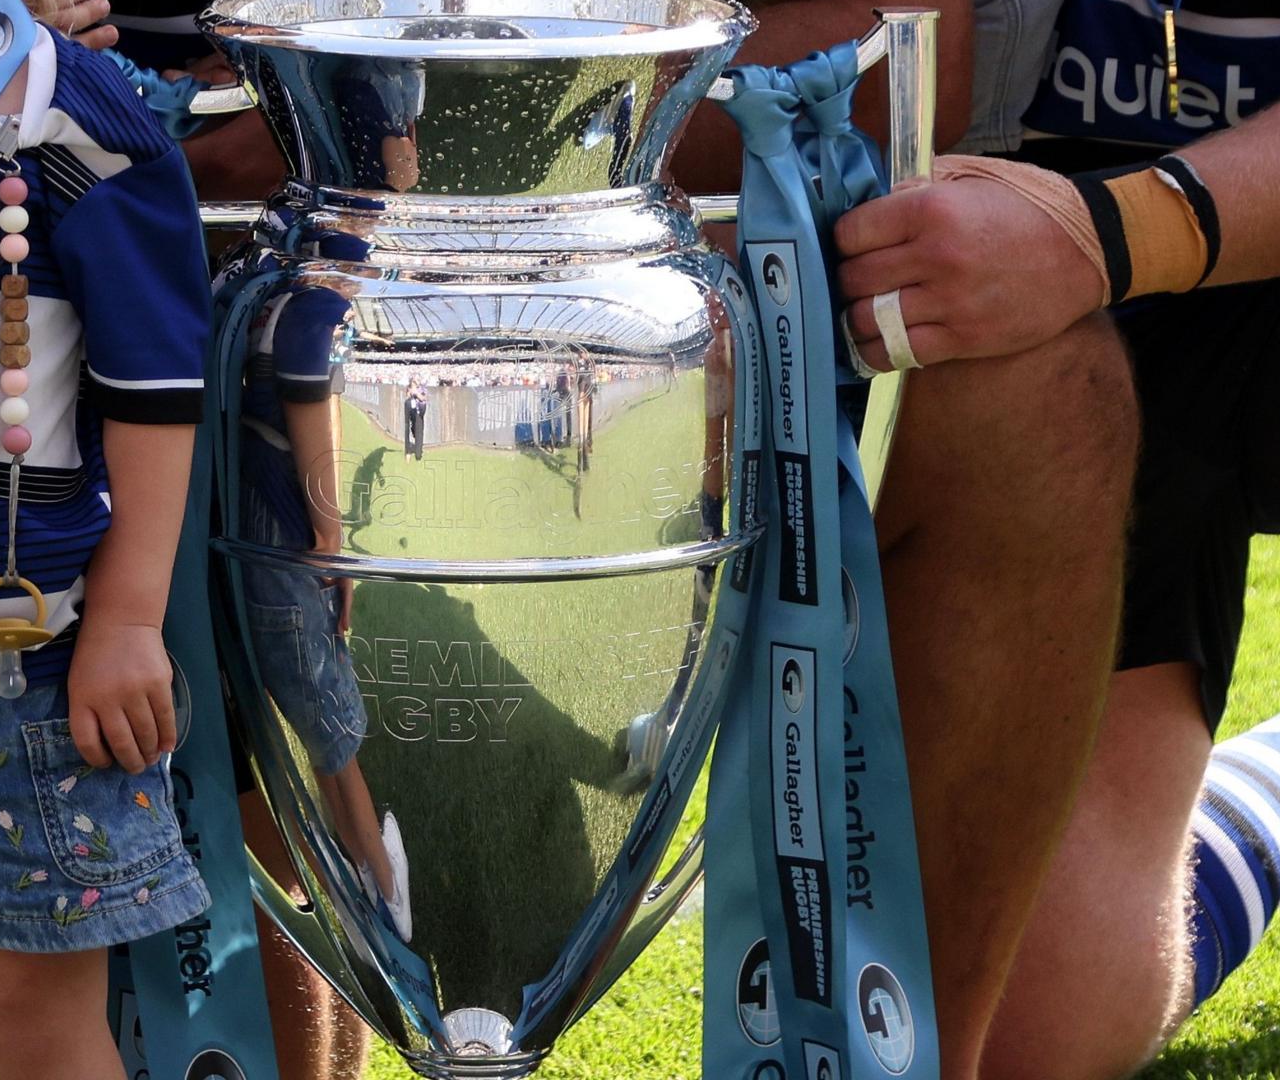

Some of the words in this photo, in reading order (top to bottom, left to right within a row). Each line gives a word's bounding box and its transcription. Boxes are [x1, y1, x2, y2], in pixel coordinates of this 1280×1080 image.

[1053, 46, 1256, 129] quiet
[776, 314, 795, 443] Gallagher
[784, 460, 796, 529] RUGBY
[793, 462, 807, 598] PREMIERSHIP
[318, 622, 703, 686] REMIERSHIP
[785, 722, 805, 850] Gallagher
[790, 866, 810, 932] RUGBY
[803, 867, 826, 998] PREMIERSHIP
